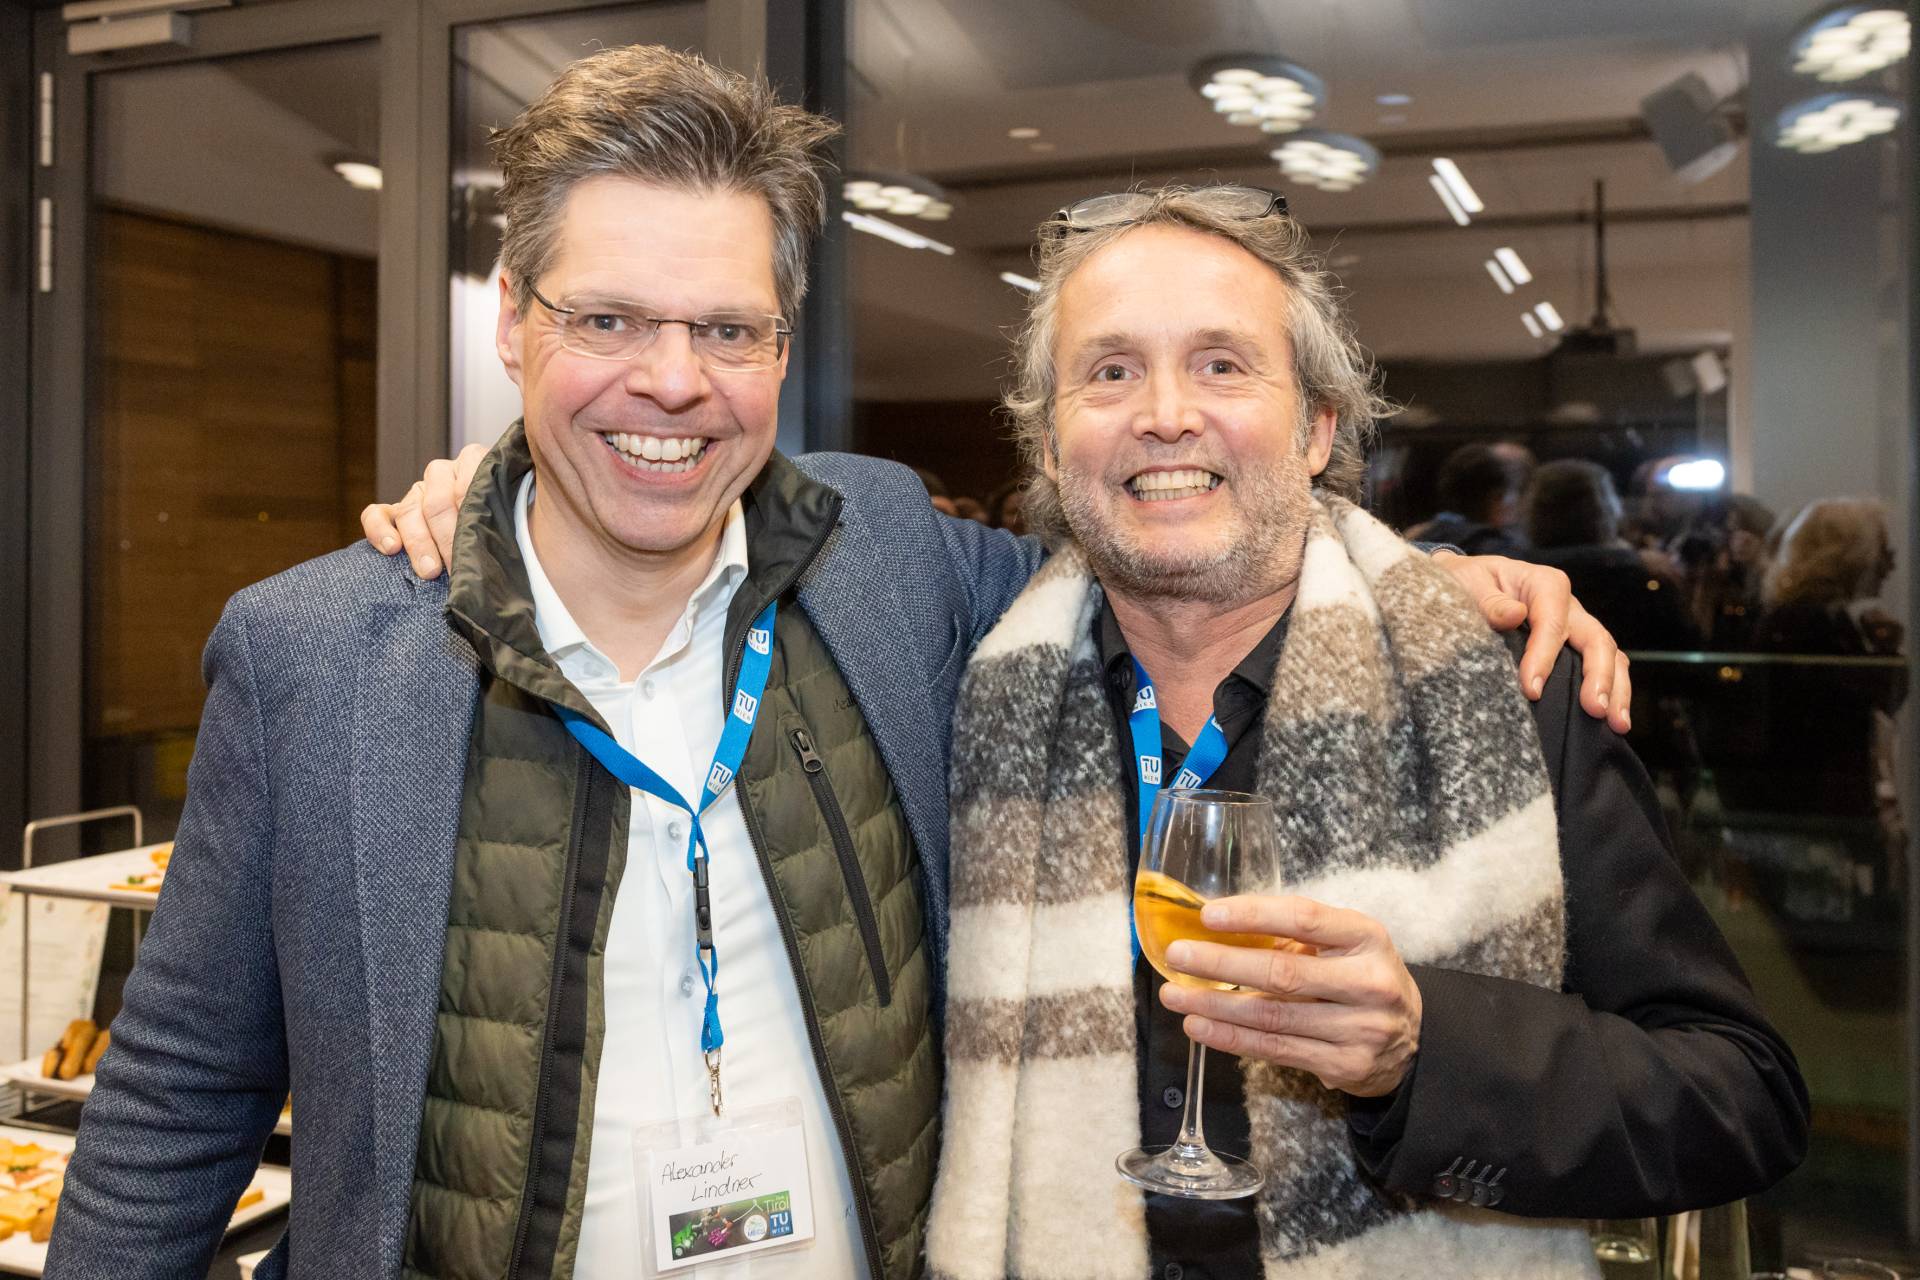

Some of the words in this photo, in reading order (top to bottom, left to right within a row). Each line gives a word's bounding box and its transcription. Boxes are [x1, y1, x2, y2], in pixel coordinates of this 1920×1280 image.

[739, 692, 755, 712] TU
[1142, 758, 1159, 773] TU
[713, 765, 731, 785] TU
[1180, 771, 1198, 788] TU
[662, 1150, 738, 1184] Alexander
[691, 1173, 762, 1201] Lindner
[764, 1195, 789, 1213] Tirol
[770, 1212, 789, 1227] TU
[772, 1226, 790, 1234] WIEN
